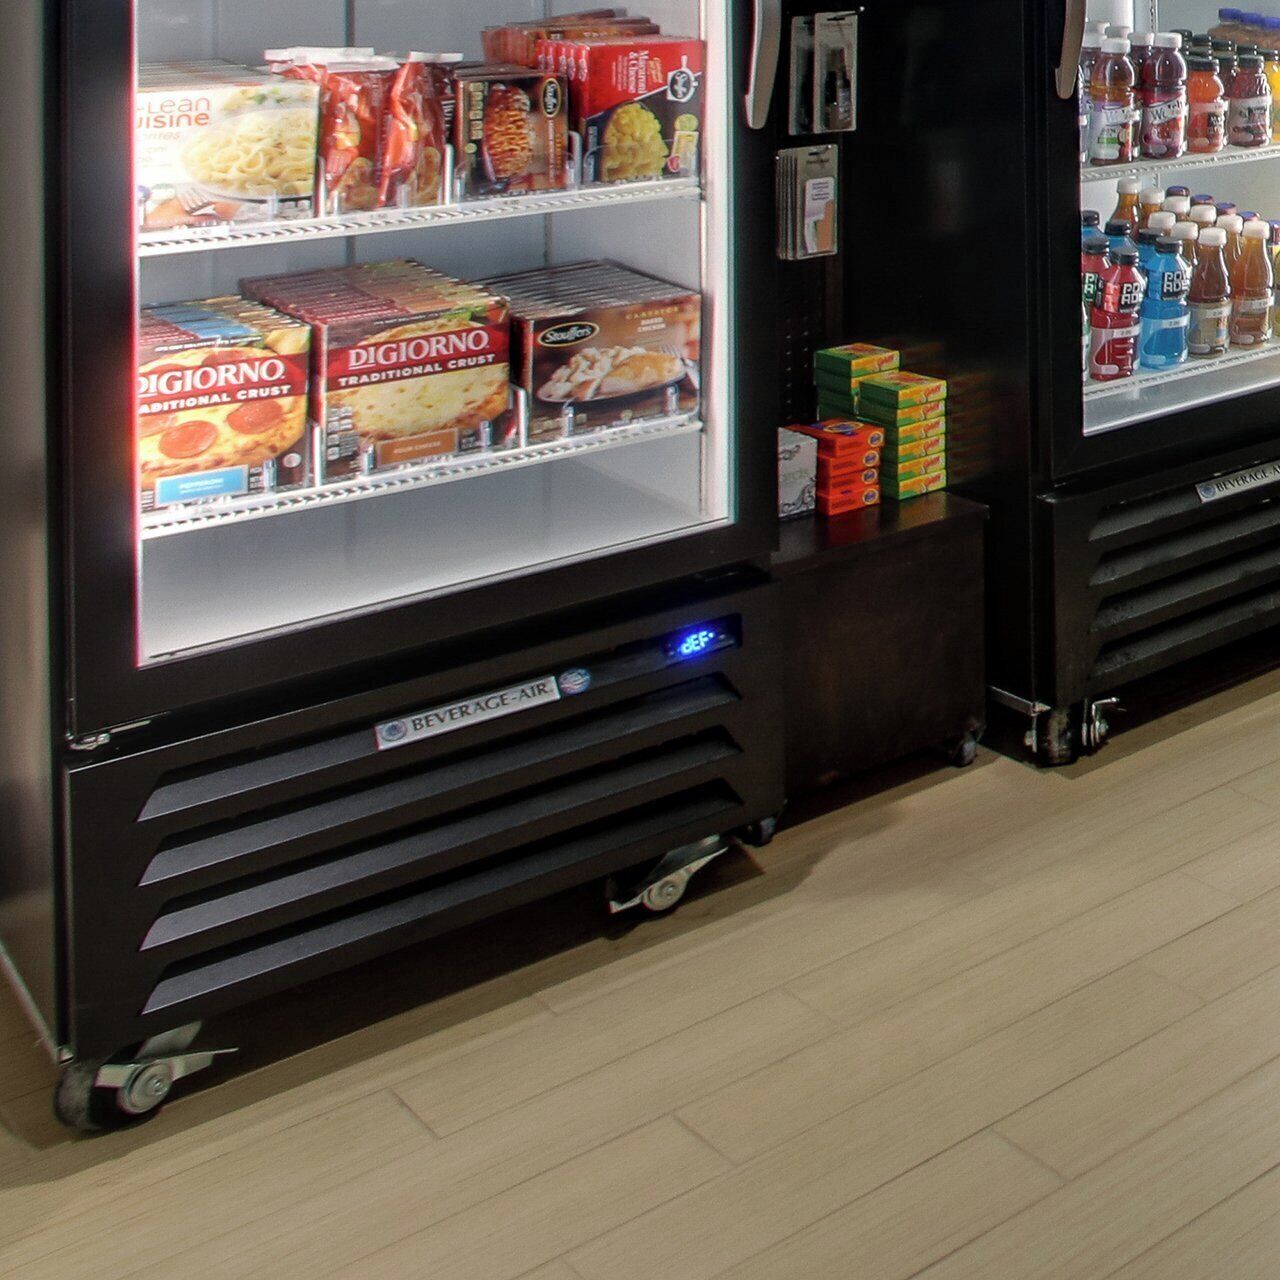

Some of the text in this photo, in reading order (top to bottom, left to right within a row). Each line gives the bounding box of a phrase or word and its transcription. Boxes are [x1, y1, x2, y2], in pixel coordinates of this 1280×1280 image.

[348, 328, 490, 369] DIGIORNO
[138, 358, 285, 396] DIGIORNO
[338, 353, 496, 387] TRADITIONAL CRUST
[237, 384, 291, 400] CRUST
[412, 681, 550, 732] BEVERAGE-AIR
